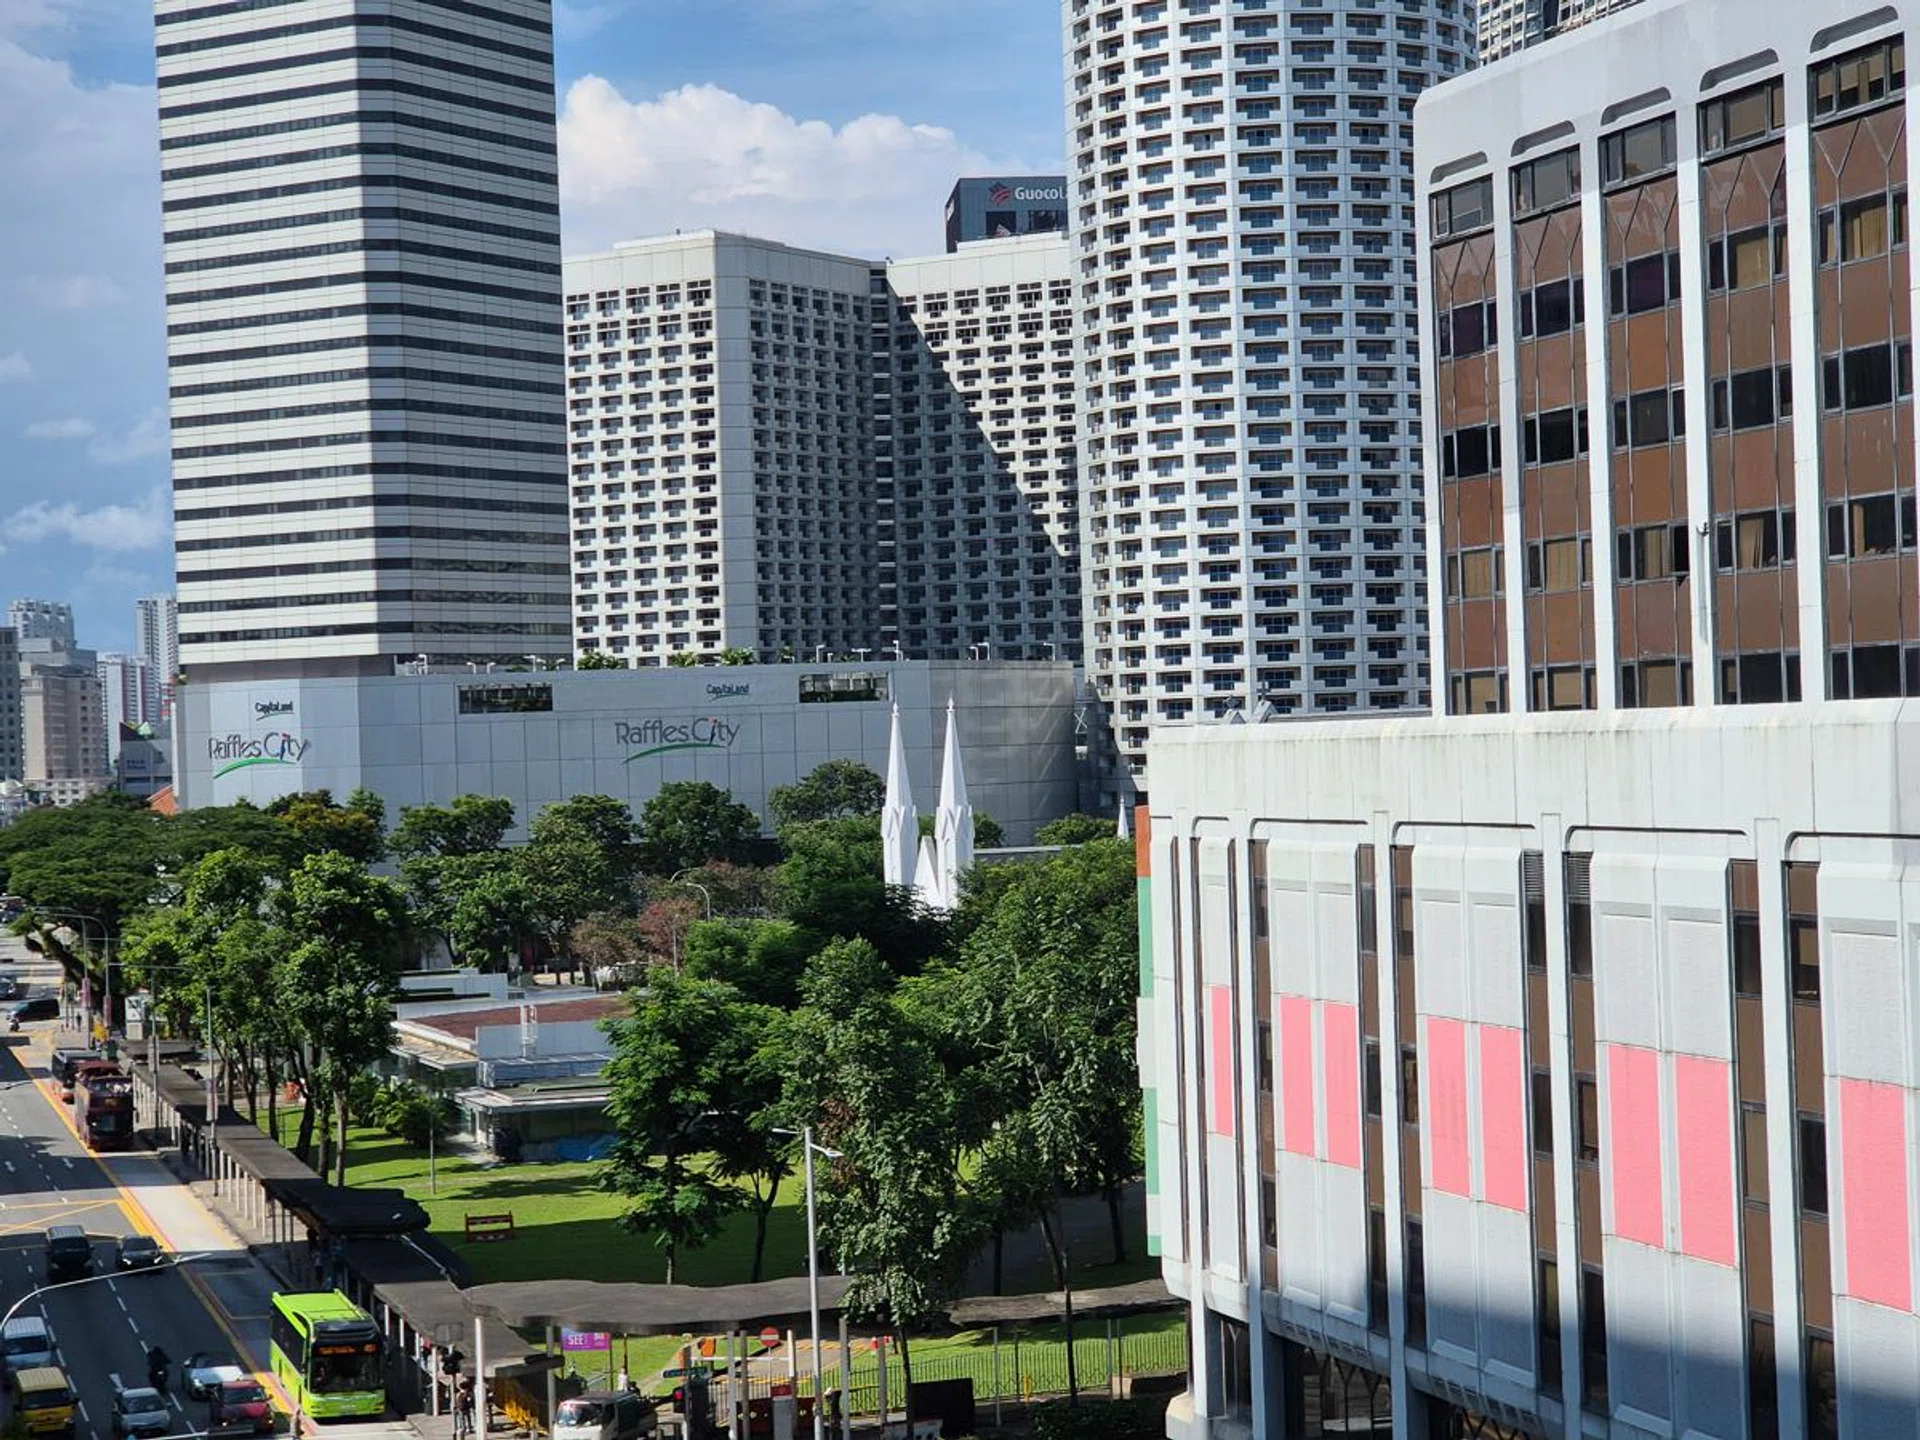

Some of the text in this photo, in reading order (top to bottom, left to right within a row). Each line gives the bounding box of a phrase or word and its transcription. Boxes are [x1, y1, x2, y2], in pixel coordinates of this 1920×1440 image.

[1014, 186, 1067, 200] GuocoL
[614, 717, 741, 746] Raffles City
[208, 732, 312, 761] Raffles City
